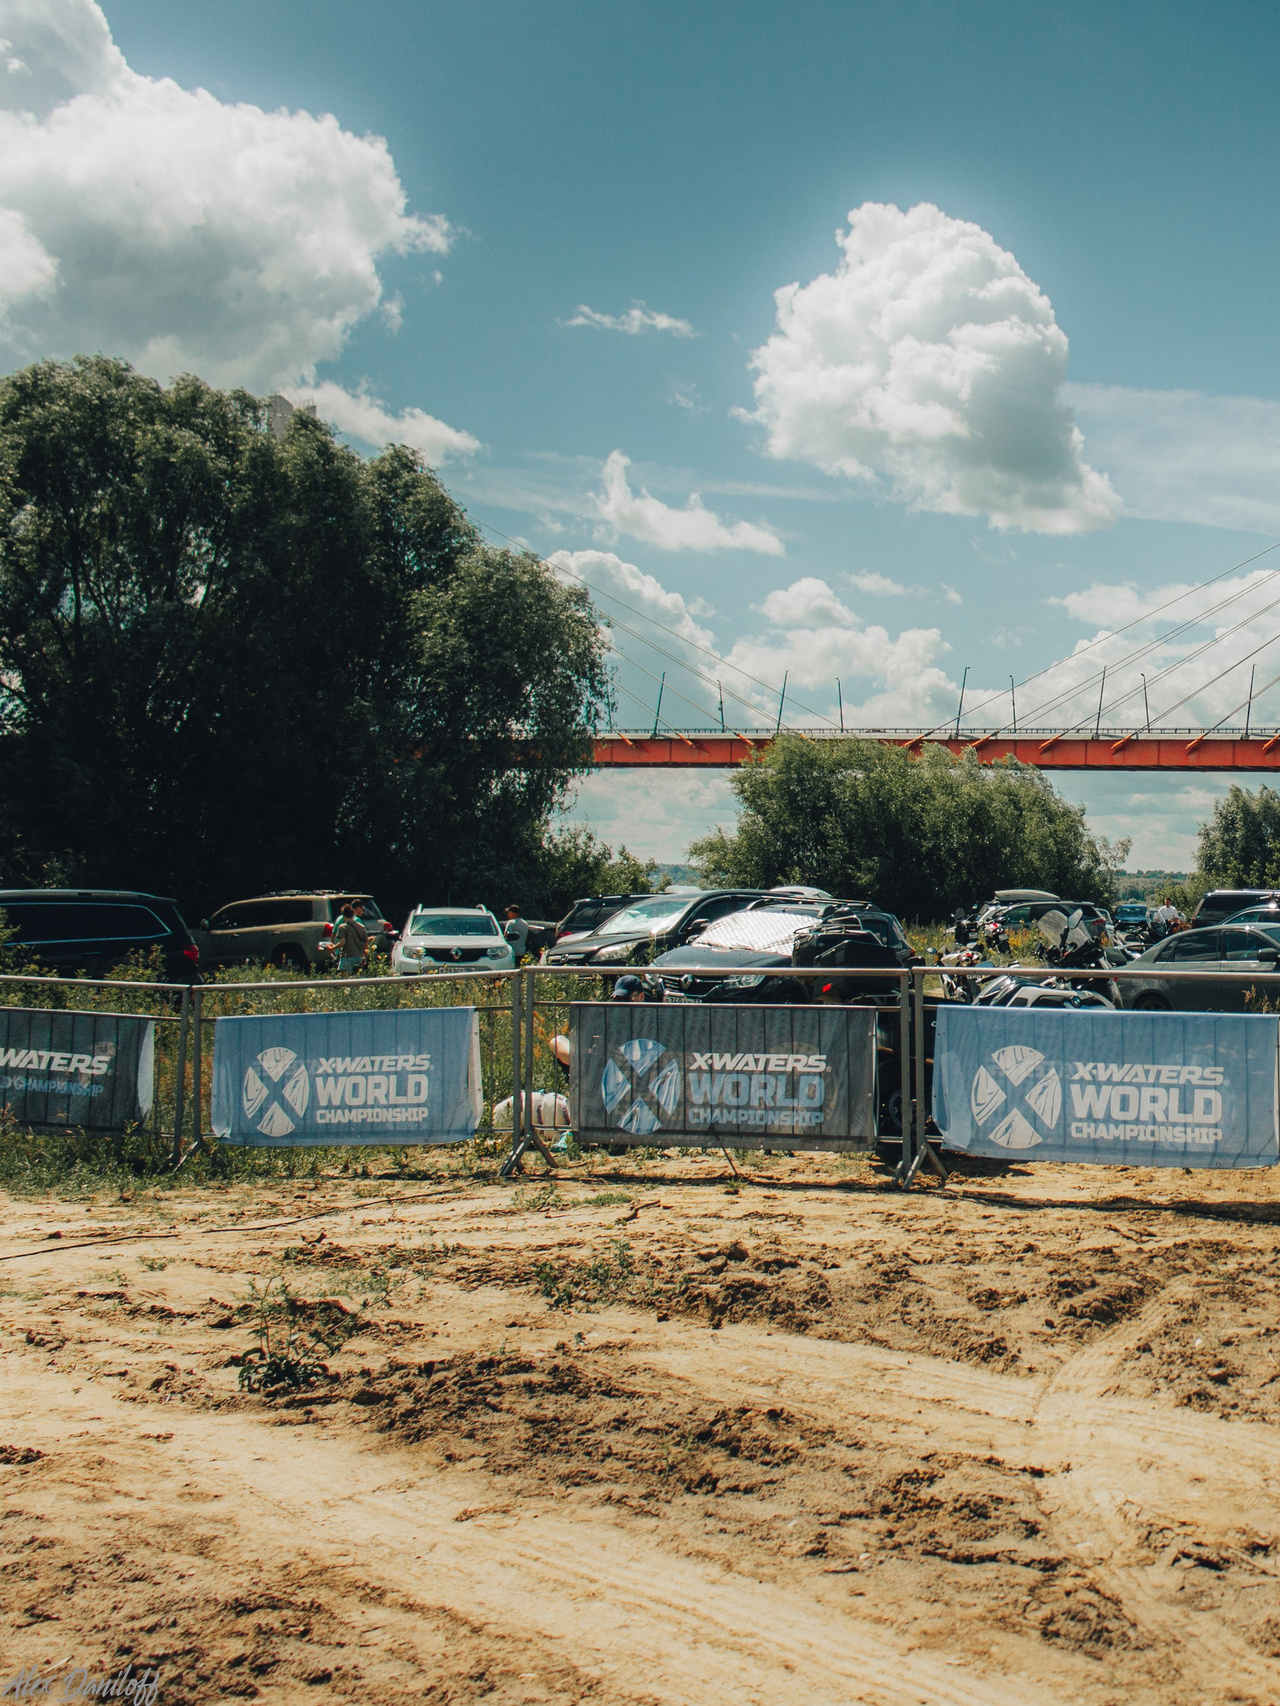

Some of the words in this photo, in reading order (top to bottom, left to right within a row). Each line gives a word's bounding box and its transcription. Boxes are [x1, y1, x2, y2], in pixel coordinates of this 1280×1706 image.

[316, 1073, 429, 1106] WORLD
[688, 1072, 826, 1107] WORLD
[316, 1107, 429, 1124] CHAMPIONSHIP
[688, 1108, 824, 1126] CHAMPIONSHIP
[1071, 1084, 1222, 1124] WORLD
[1071, 1121, 1222, 1144] CHAMPIONSHIP
